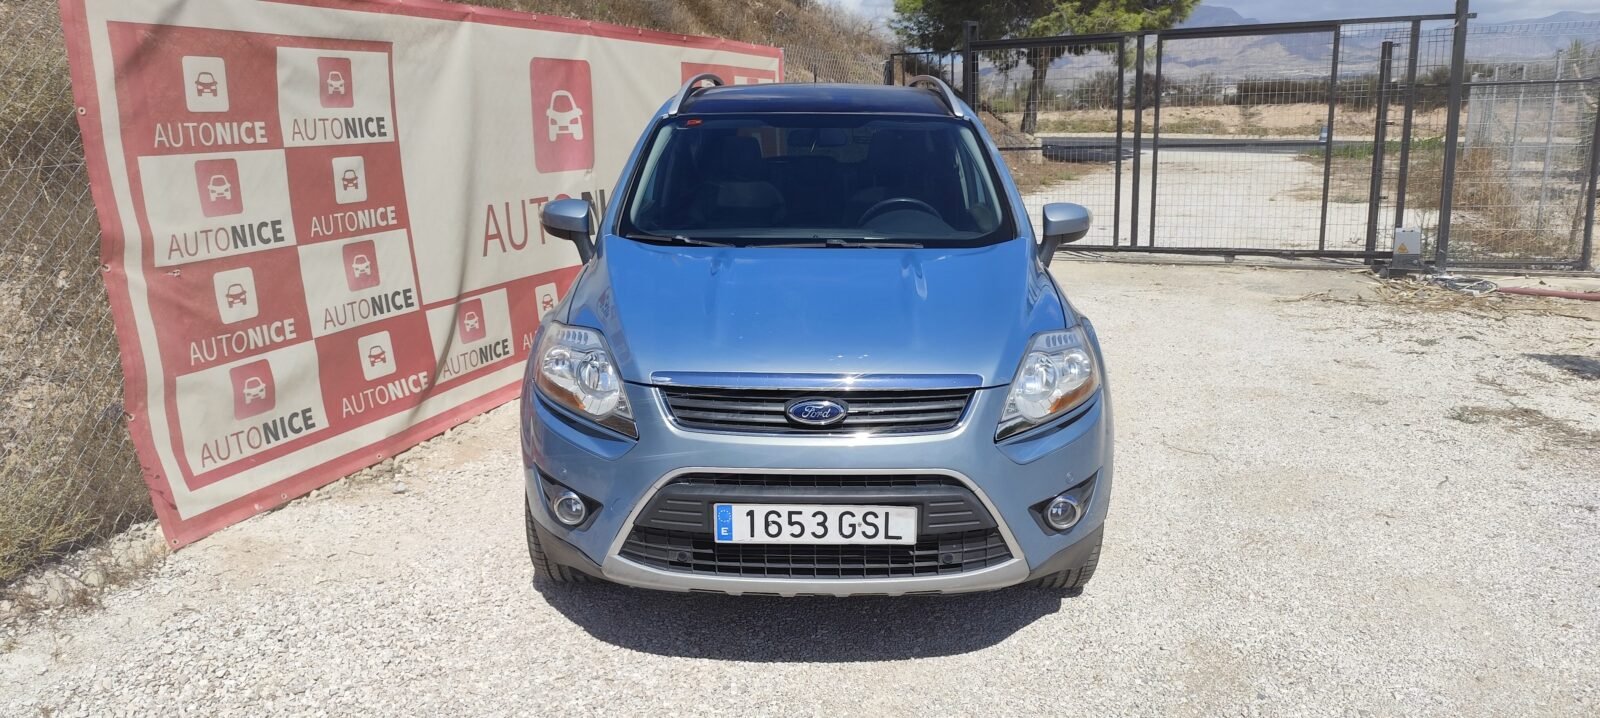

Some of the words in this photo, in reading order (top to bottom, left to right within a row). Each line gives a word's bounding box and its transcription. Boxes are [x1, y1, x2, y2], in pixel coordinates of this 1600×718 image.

[154, 122, 267, 148] AUTONICE
[292, 117, 387, 142] AUTONICE
[168, 220, 285, 260] AUTONICE
[311, 206, 397, 237] AUTONICE
[323, 288, 414, 329] AUTONICE
[190, 318, 297, 366] AUTONICE
[443, 338, 509, 378] AUTONICE
[341, 371, 429, 418] AUTONICE
[801, 403, 831, 419] Ford
[201, 408, 316, 467] AUTONICE
[746, 509, 829, 539] 1653
[838, 510, 902, 540] GSL
